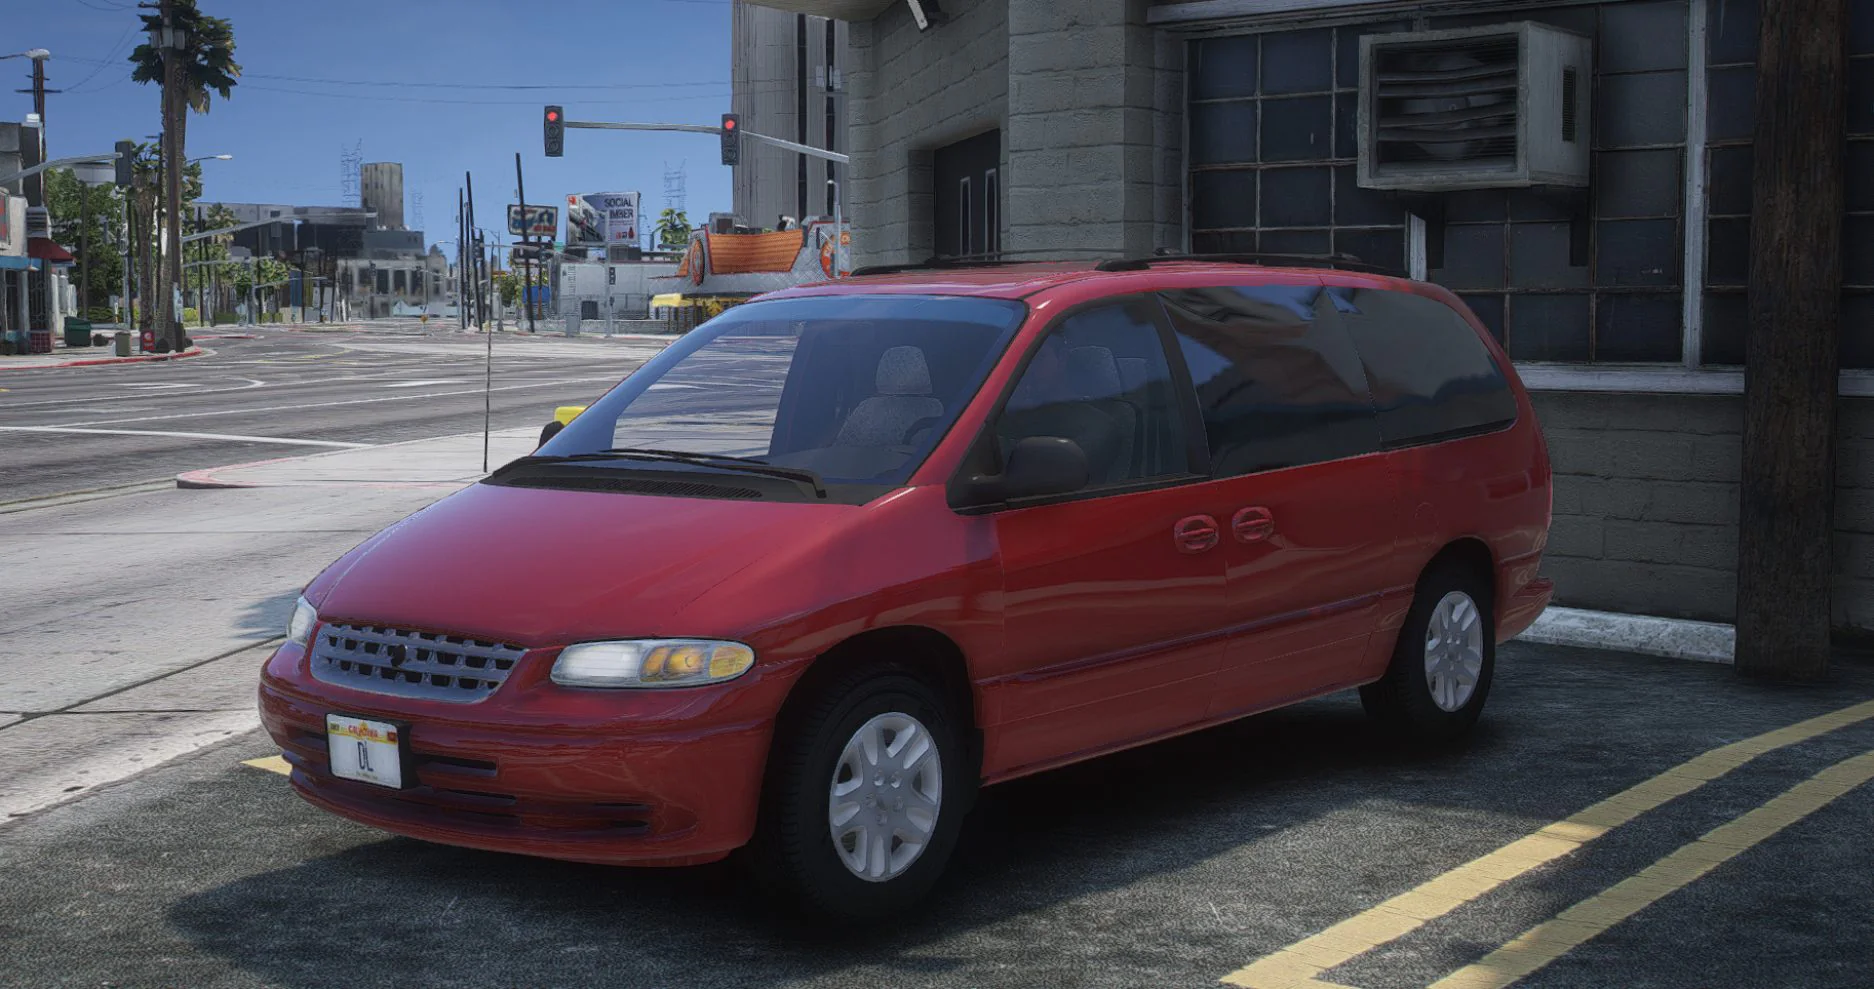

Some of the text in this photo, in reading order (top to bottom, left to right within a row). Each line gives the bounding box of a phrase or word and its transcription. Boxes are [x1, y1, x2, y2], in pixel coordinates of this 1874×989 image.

[604, 198, 633, 208] SOCIAL
[606, 208, 634, 219] IMBER
[357, 741, 374, 772] DL
